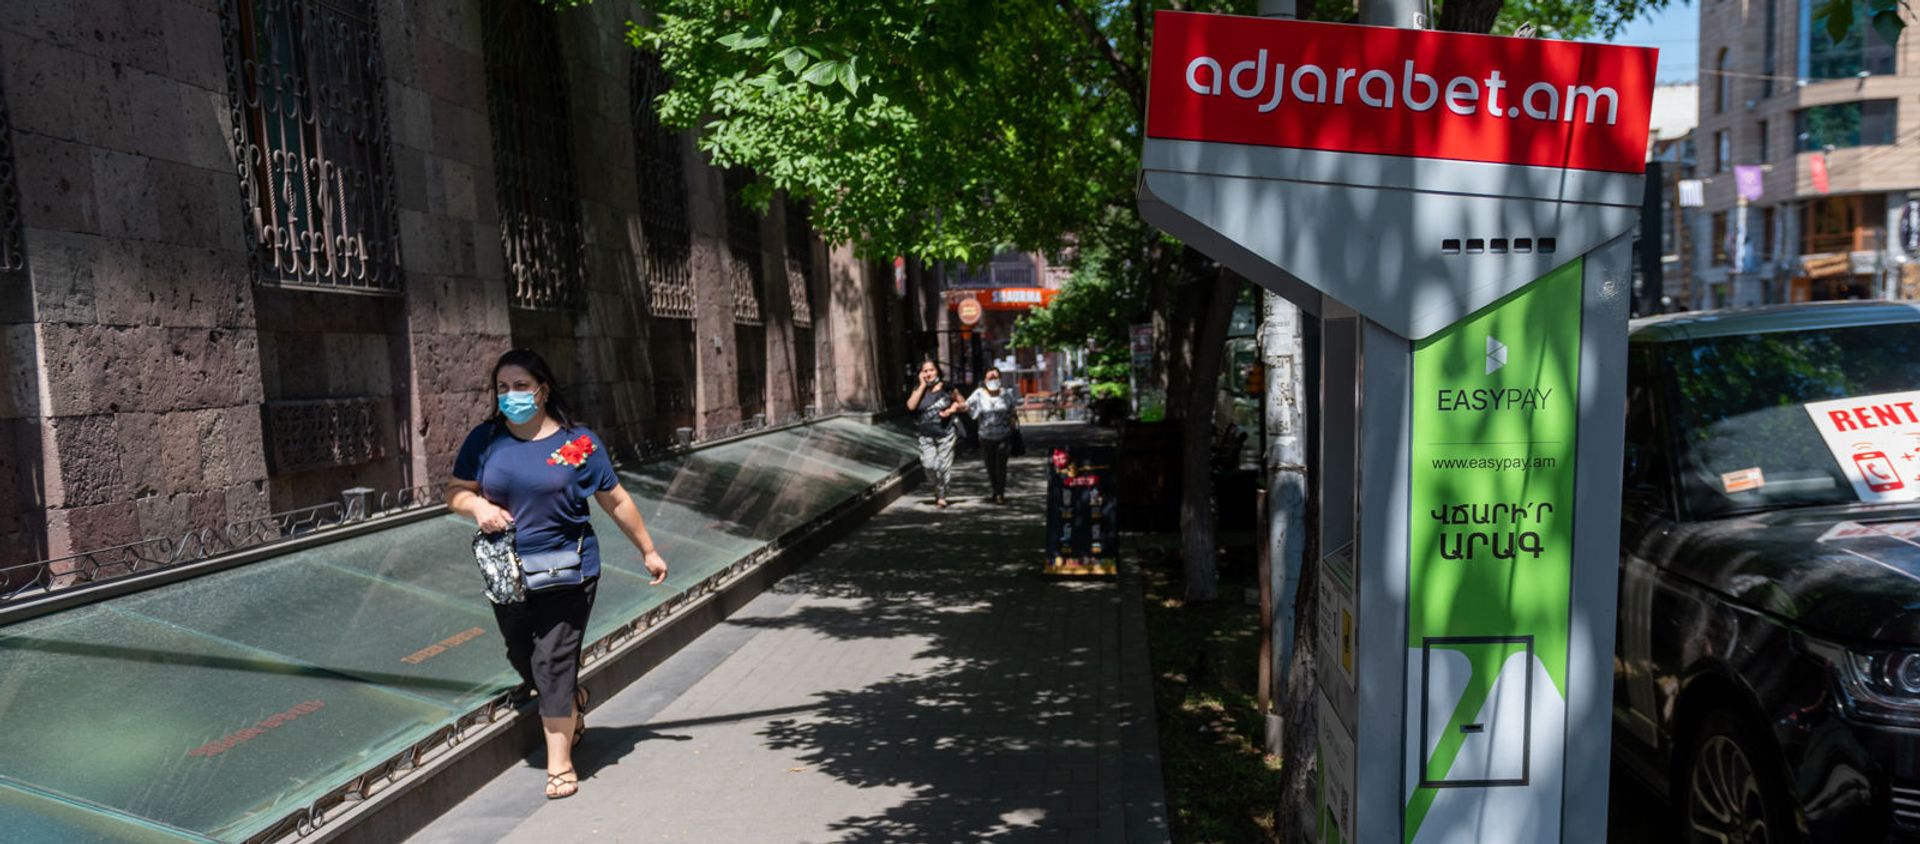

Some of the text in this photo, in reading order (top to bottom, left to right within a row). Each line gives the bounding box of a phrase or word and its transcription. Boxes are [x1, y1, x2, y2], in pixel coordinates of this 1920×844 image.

[1185, 48, 1619, 125] adjarabet.am
[1437, 388, 1552, 411] EASYPAY
[1828, 402, 1919, 432] RENT
[1432, 457, 1555, 472] www.easypay.am
[1440, 531, 1545, 560] ԱՐԱԳ
